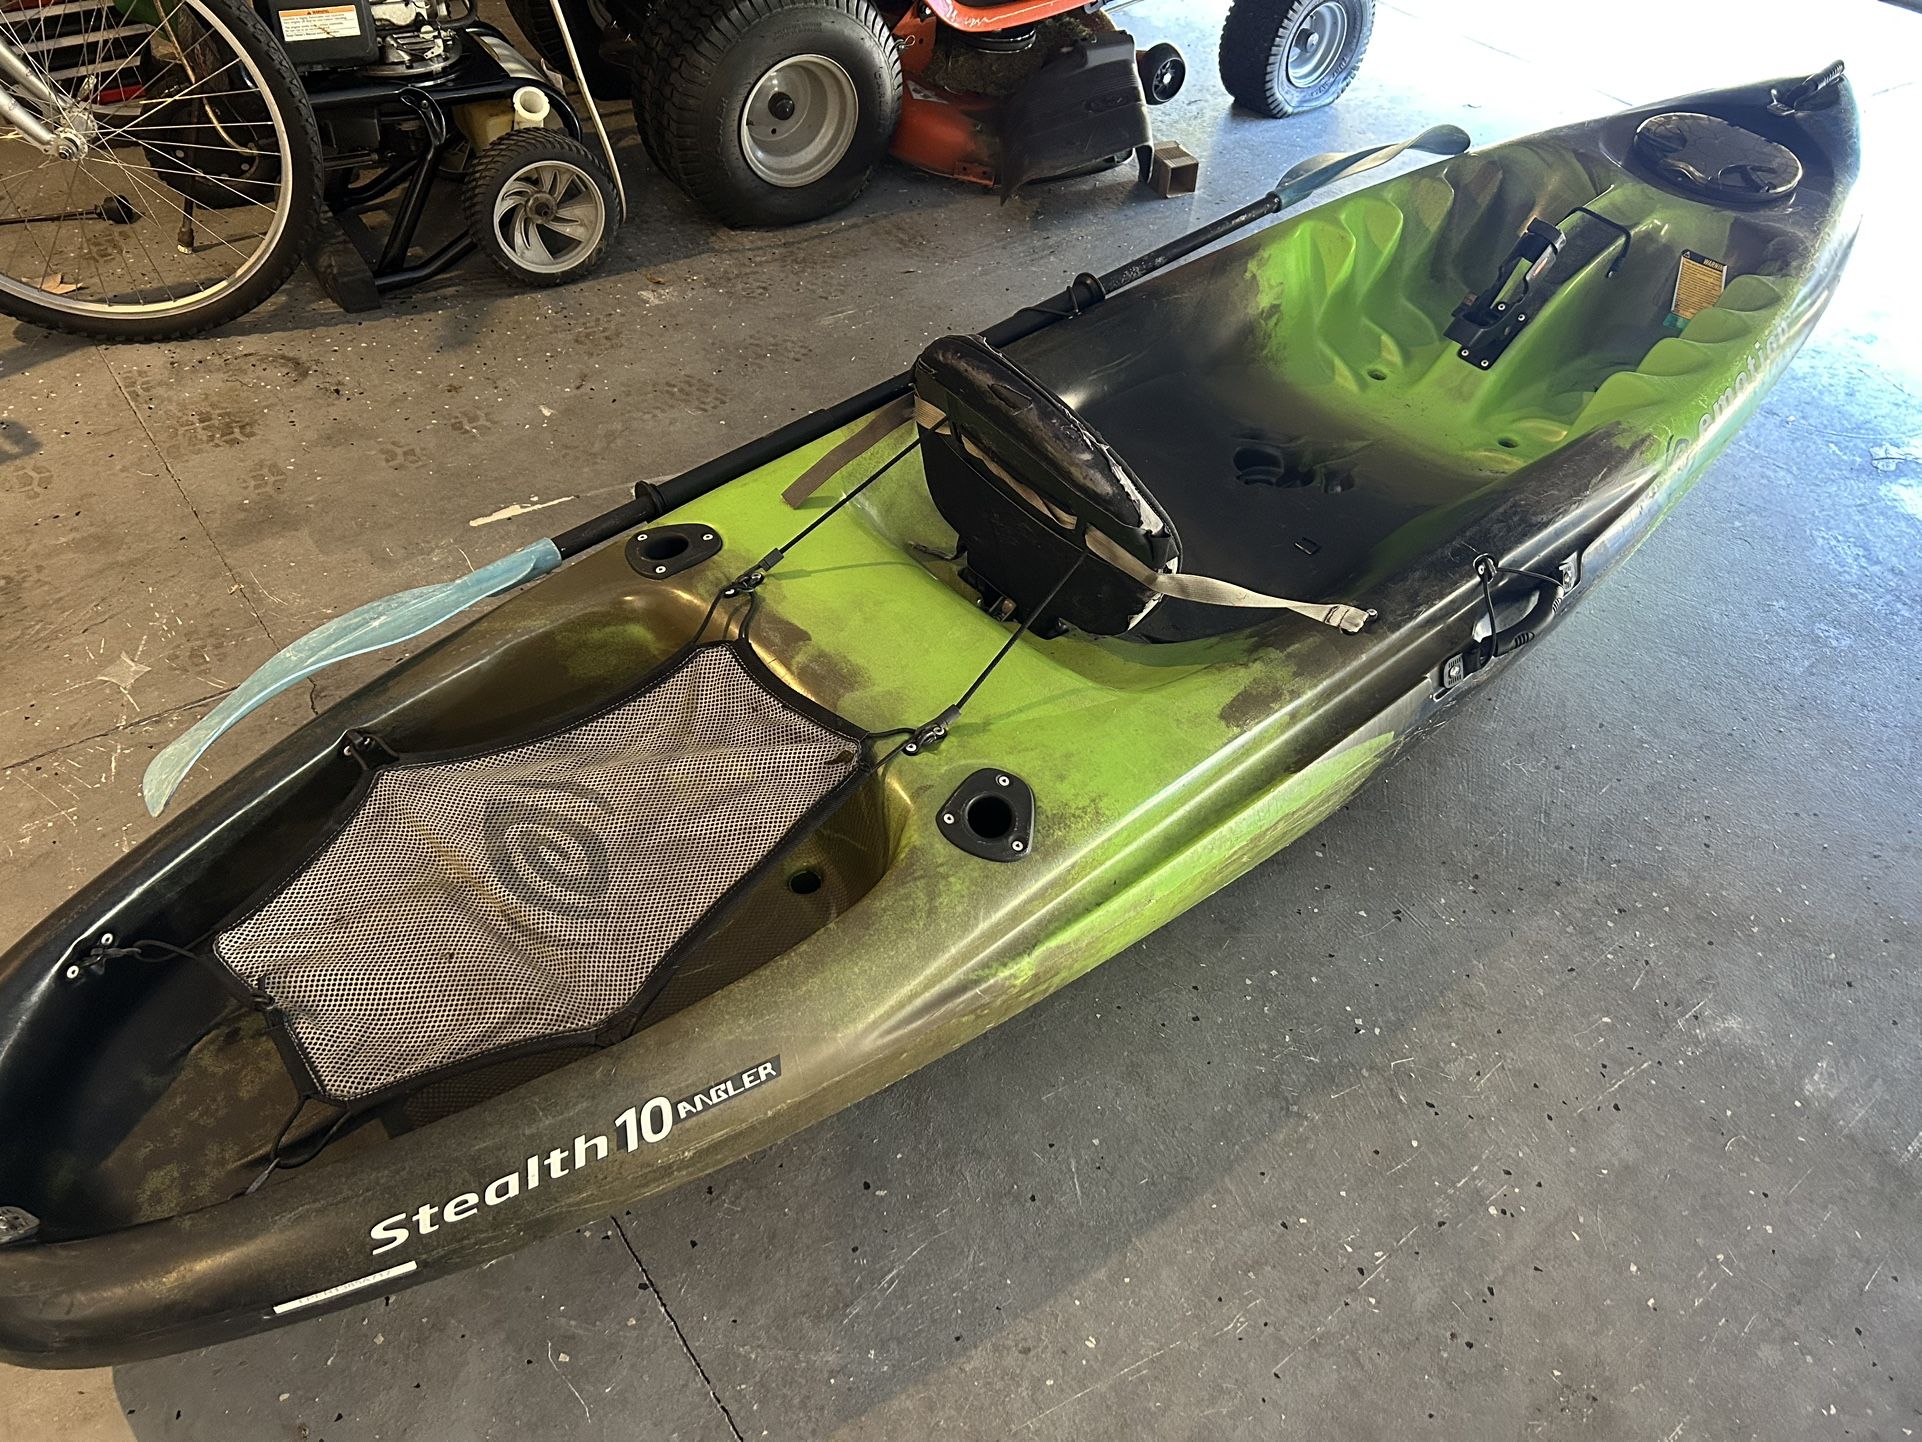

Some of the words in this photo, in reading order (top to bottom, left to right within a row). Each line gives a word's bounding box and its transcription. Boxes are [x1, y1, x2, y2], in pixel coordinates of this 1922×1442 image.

[370, 1134, 608, 1256] Stealth
[614, 1096, 673, 1153] 10
[677, 1062, 777, 1119] ANGLER
